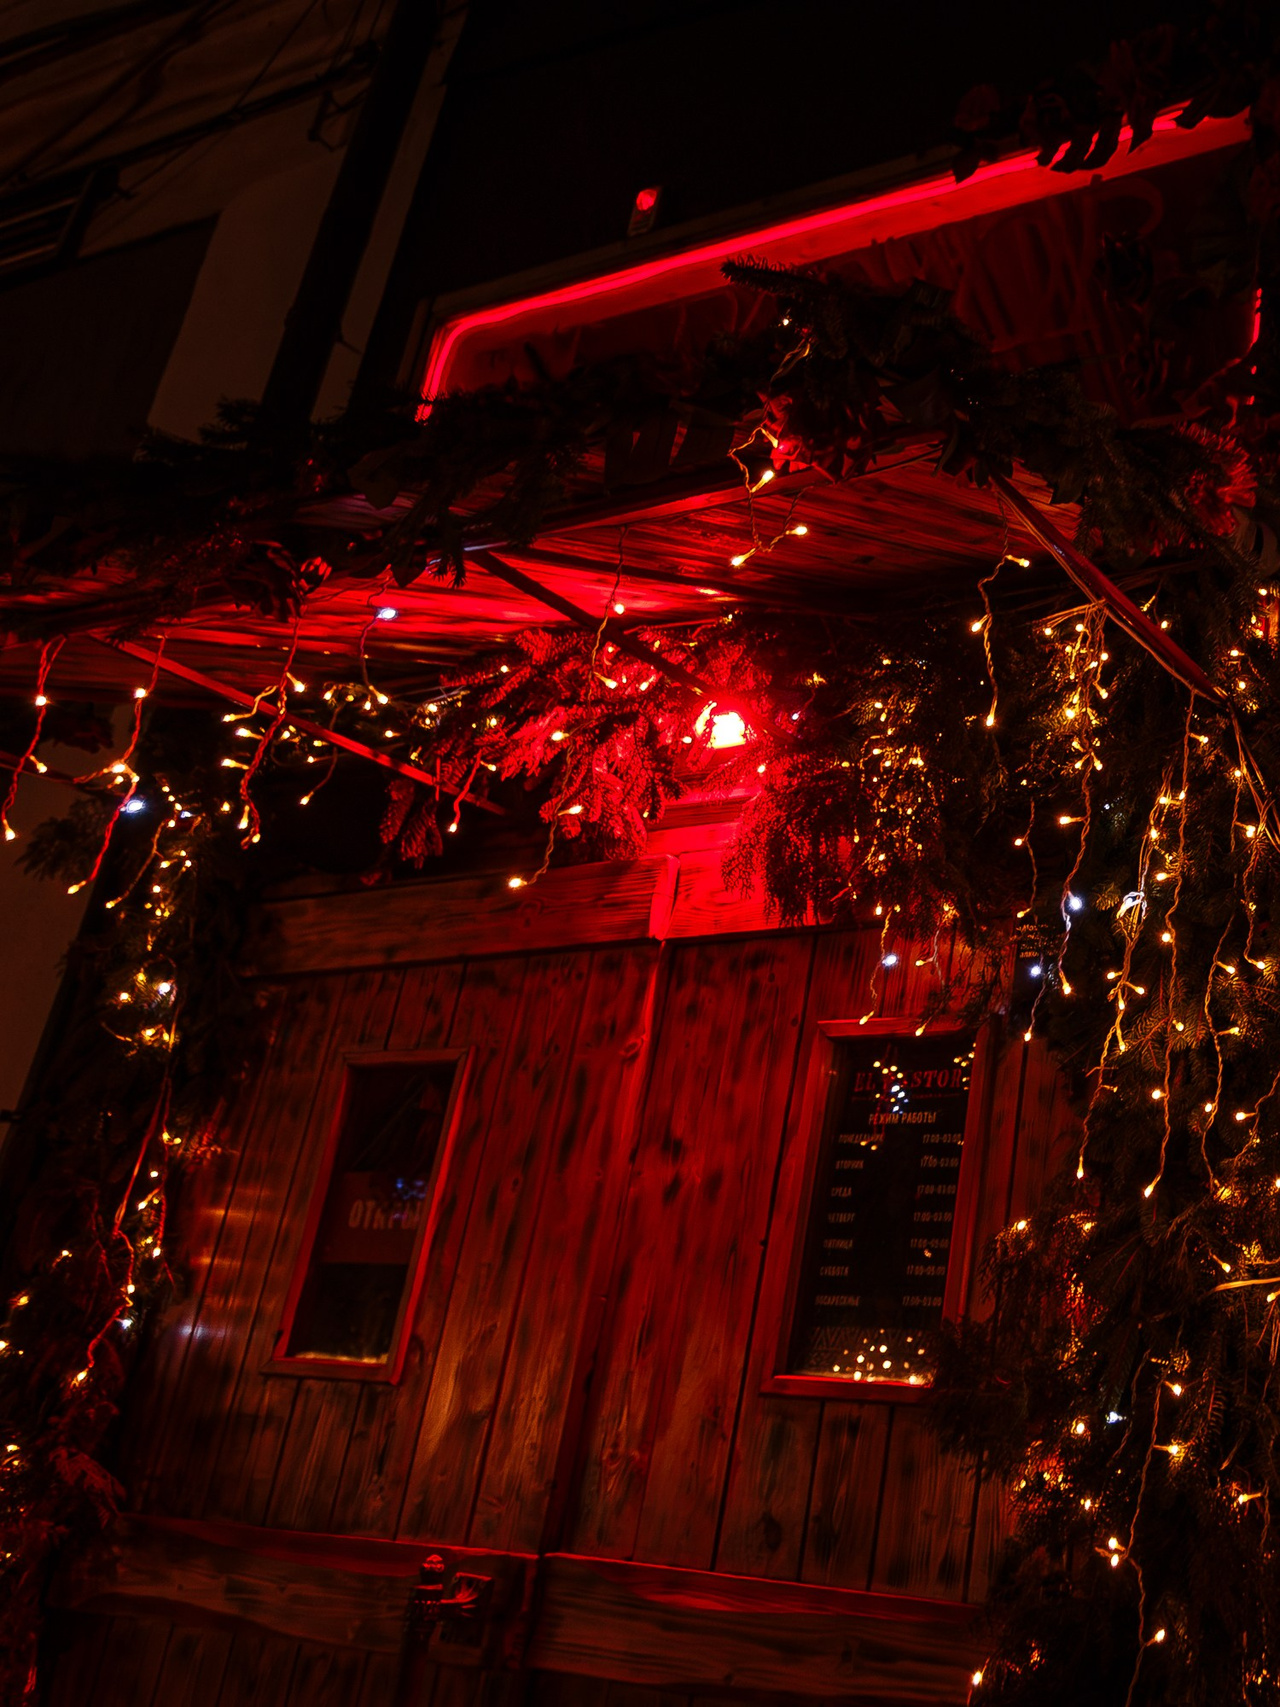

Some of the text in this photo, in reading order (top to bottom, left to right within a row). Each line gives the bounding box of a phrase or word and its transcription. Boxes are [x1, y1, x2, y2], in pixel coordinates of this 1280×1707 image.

[853, 1071, 876, 1093] EL
[868, 1111, 937, 1126] РЕЖИМ РАБОТЫ
